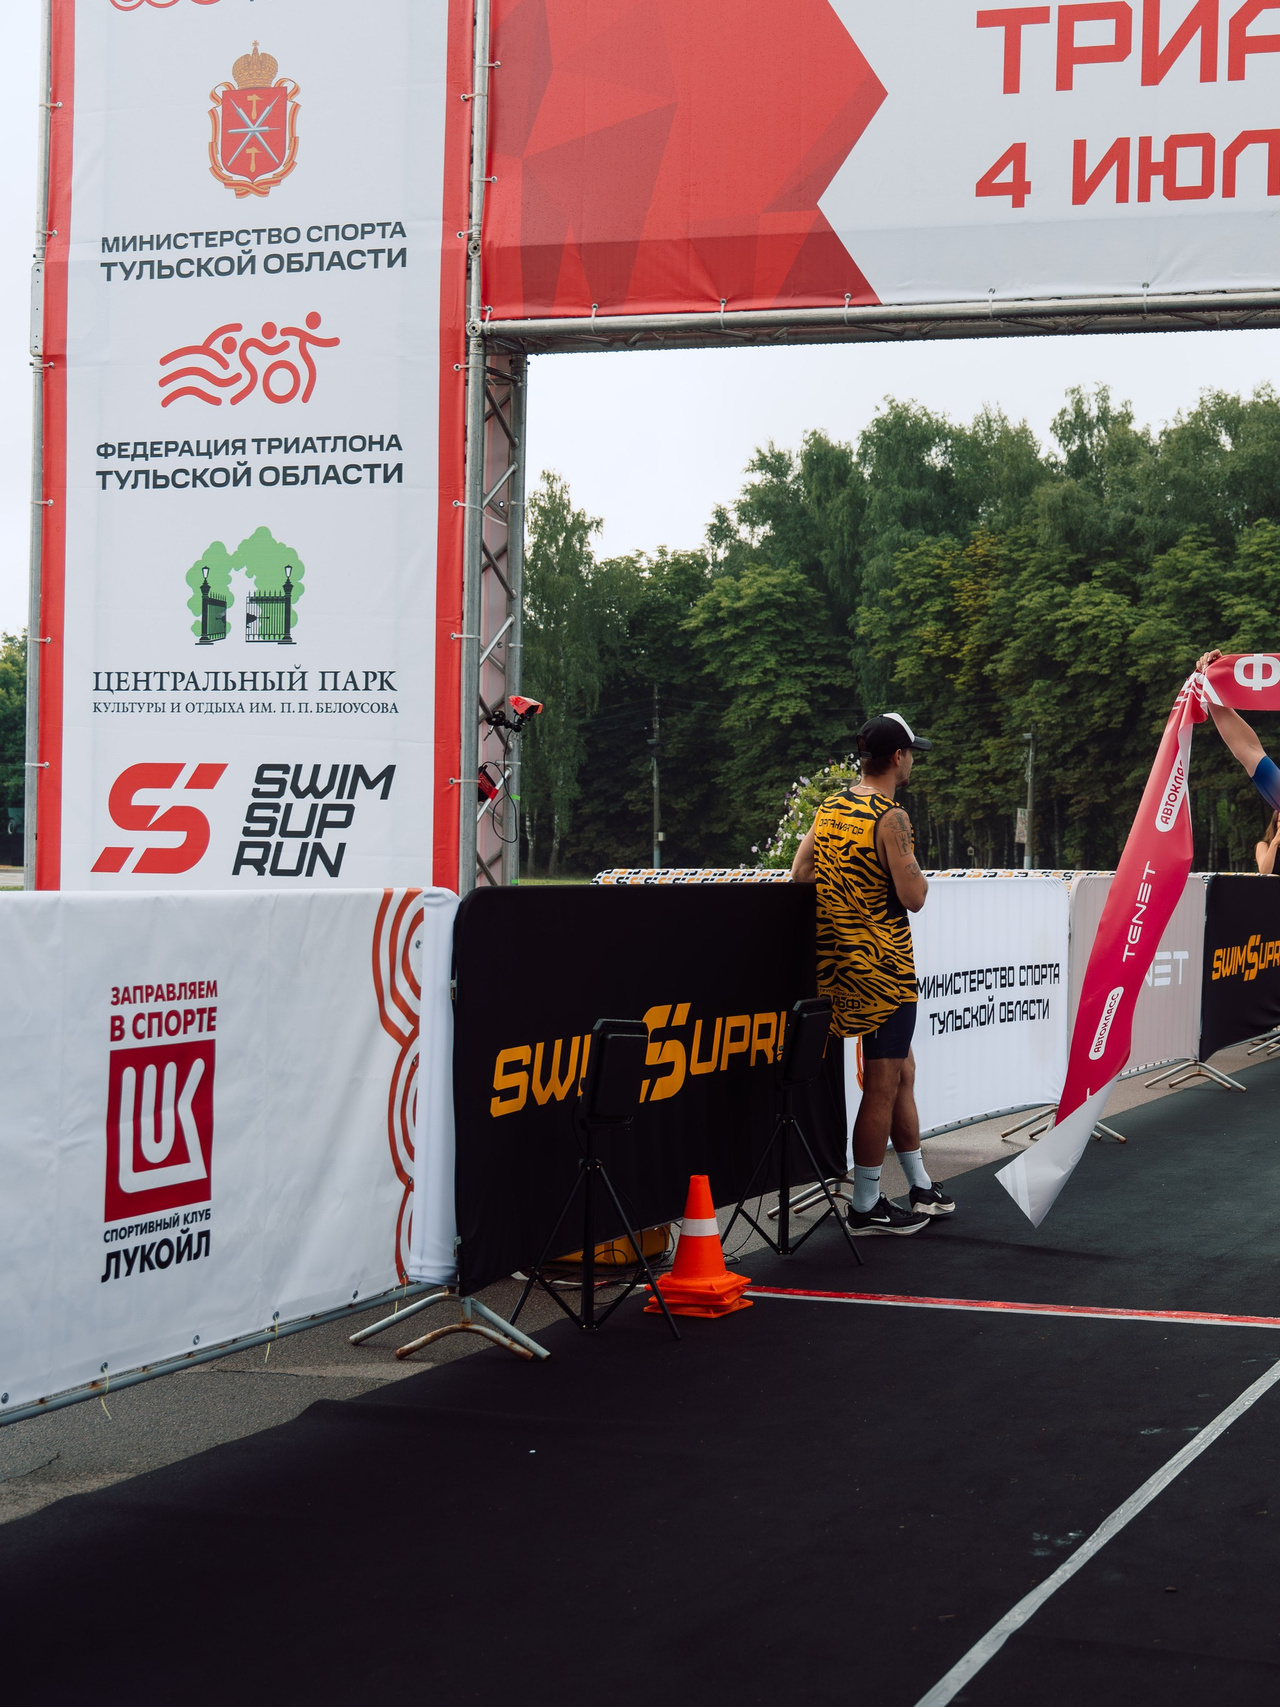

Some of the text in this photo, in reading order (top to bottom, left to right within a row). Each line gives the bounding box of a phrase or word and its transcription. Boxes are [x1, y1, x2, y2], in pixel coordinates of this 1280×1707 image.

[975, 143, 1032, 209] 4
[101, 221, 407, 254] МИНИСТЕРСТВО СПОРТА
[100, 247, 407, 282] ТУЛЬСКОЙ ОБЛАСТИ
[96, 434, 403, 461] ФЕДЕРАЦИЯ ТРИАТЛОНА
[96, 461, 403, 490] ТУЛЬСКОЙ ОБЛАСТИ
[92, 664, 398, 695] ЦЕНТРАЛЬНЫЙ ПАРК
[92, 702, 399, 715] КУЛЬТУРЫ И ОТДЫХА ИМ. П. П. БЕЛОУСОВА
[251, 763, 397, 800] SWIM
[241, 802, 356, 839] SUP
[232, 841, 347, 878] RUN
[1122, 861, 1156, 963] TENET
[111, 980, 218, 1006] ЗАПРАВЛЯЕМ
[916, 963, 1060, 1003] МИНИСТЕРСТВО СПОРТА
[110, 1006, 217, 1042] В СПОРТЕ
[929, 995, 1050, 1036] ТУЛЬСКОЙ ОБЛАСТИ
[1093, 993, 1119, 1054] АВТОКЛАСС
[103, 1208, 211, 1244] СПОРТИВНЫЙ КЛУБ
[101, 1228, 211, 1283] ЛУКОЙЛ
